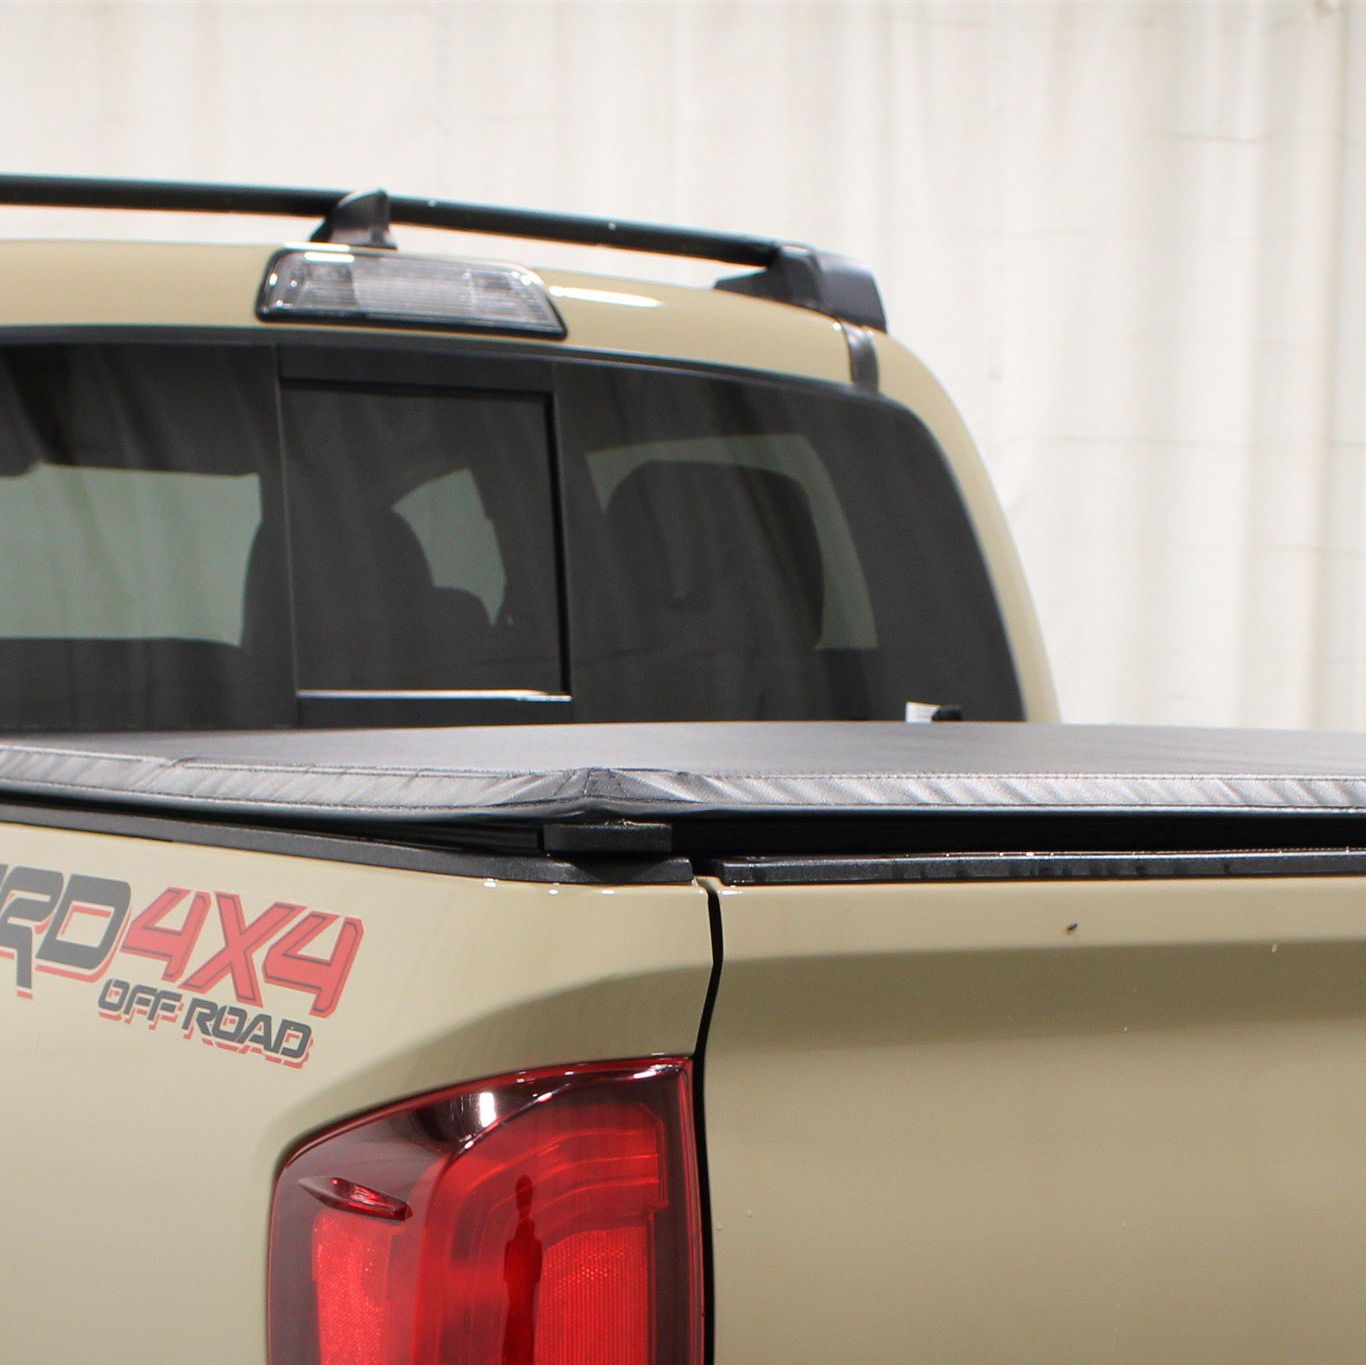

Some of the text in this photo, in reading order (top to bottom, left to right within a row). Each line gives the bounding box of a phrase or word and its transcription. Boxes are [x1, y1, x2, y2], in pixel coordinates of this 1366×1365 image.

[120, 886, 365, 1019] 4X4
[97, 977, 315, 1069] OFF ROAD
